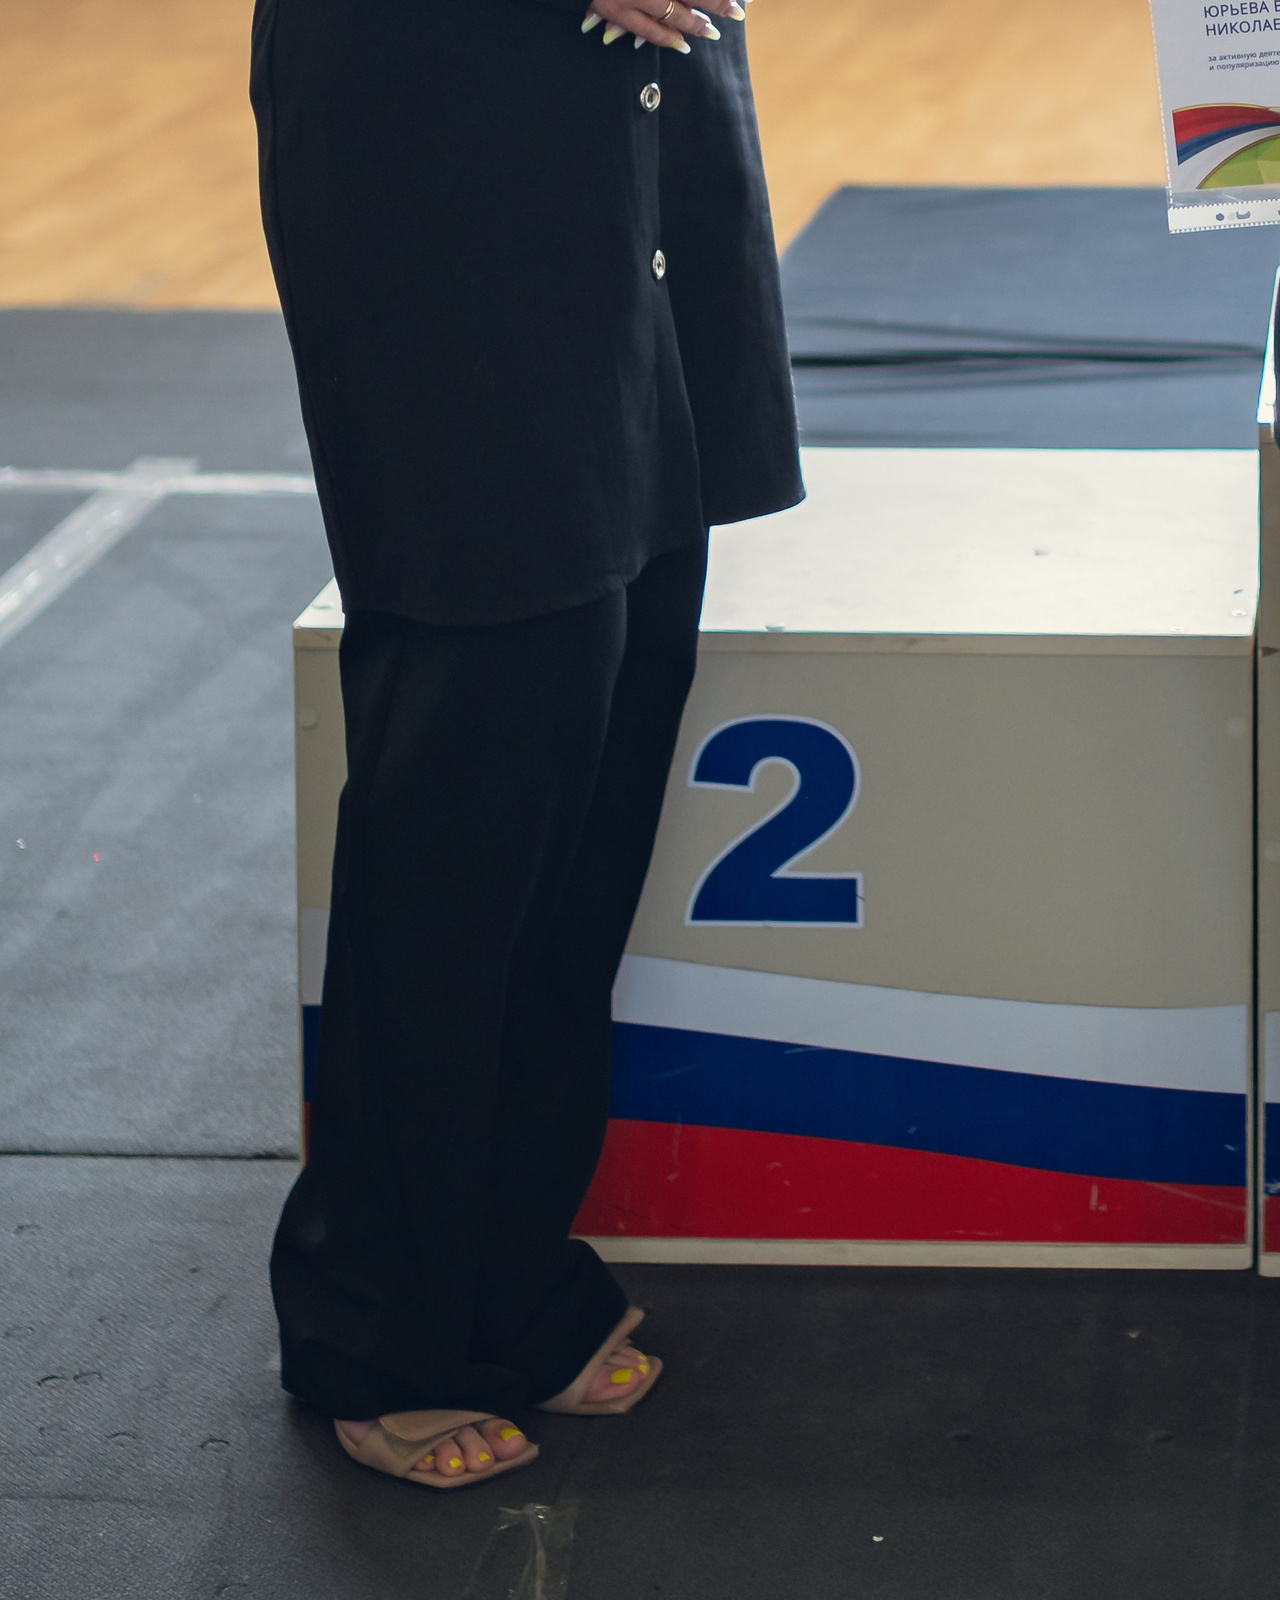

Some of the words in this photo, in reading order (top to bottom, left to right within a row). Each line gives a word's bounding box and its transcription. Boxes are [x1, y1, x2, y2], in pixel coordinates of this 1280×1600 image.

[1203, 0, 1270, 18] ЮРЬЕВА
[1218, 52, 1257, 62] активную
[1216, 59, 1280, 71] популяризацию
[685, 713, 865, 928] 2
